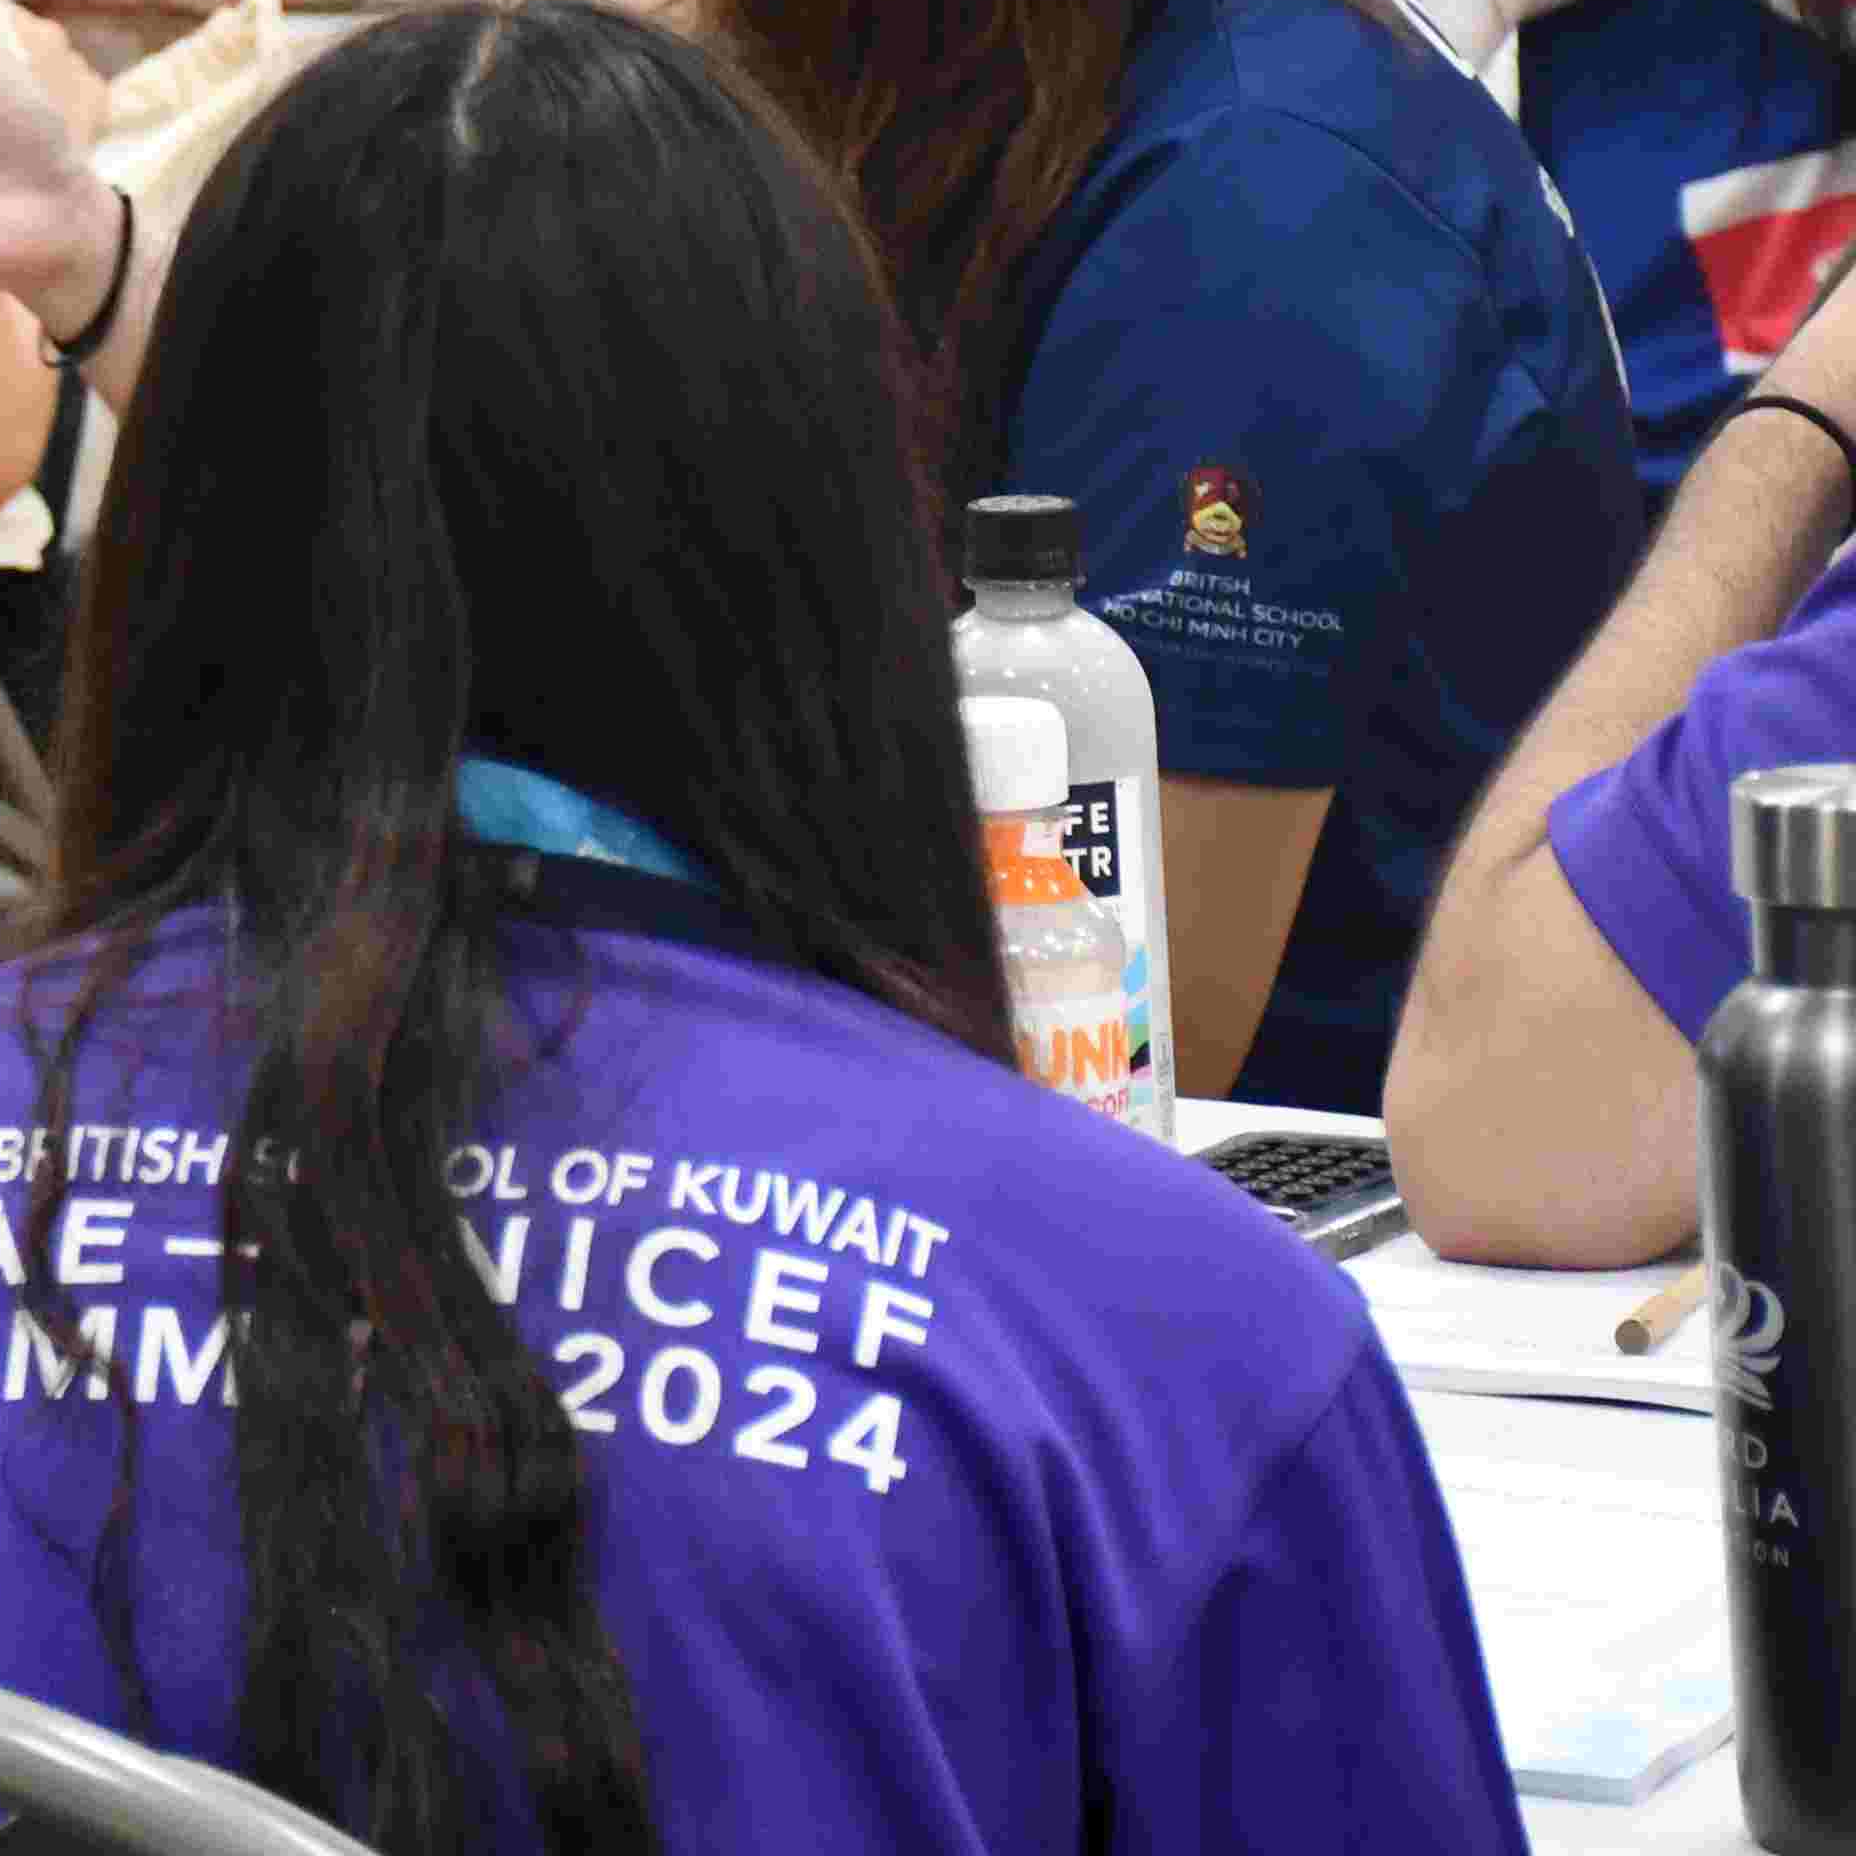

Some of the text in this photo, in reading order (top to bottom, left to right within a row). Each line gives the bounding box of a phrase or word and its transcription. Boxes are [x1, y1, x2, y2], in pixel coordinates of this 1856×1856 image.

[1187, 619, 1248, 642] MINH
[1252, 627, 1306, 650] CITY
[1250, 602, 1345, 633] SCHOOL
[550, 1148, 654, 1207] OF
[667, 1159, 951, 1279] KUWAIT
[553, 1331, 908, 1495] 2024
